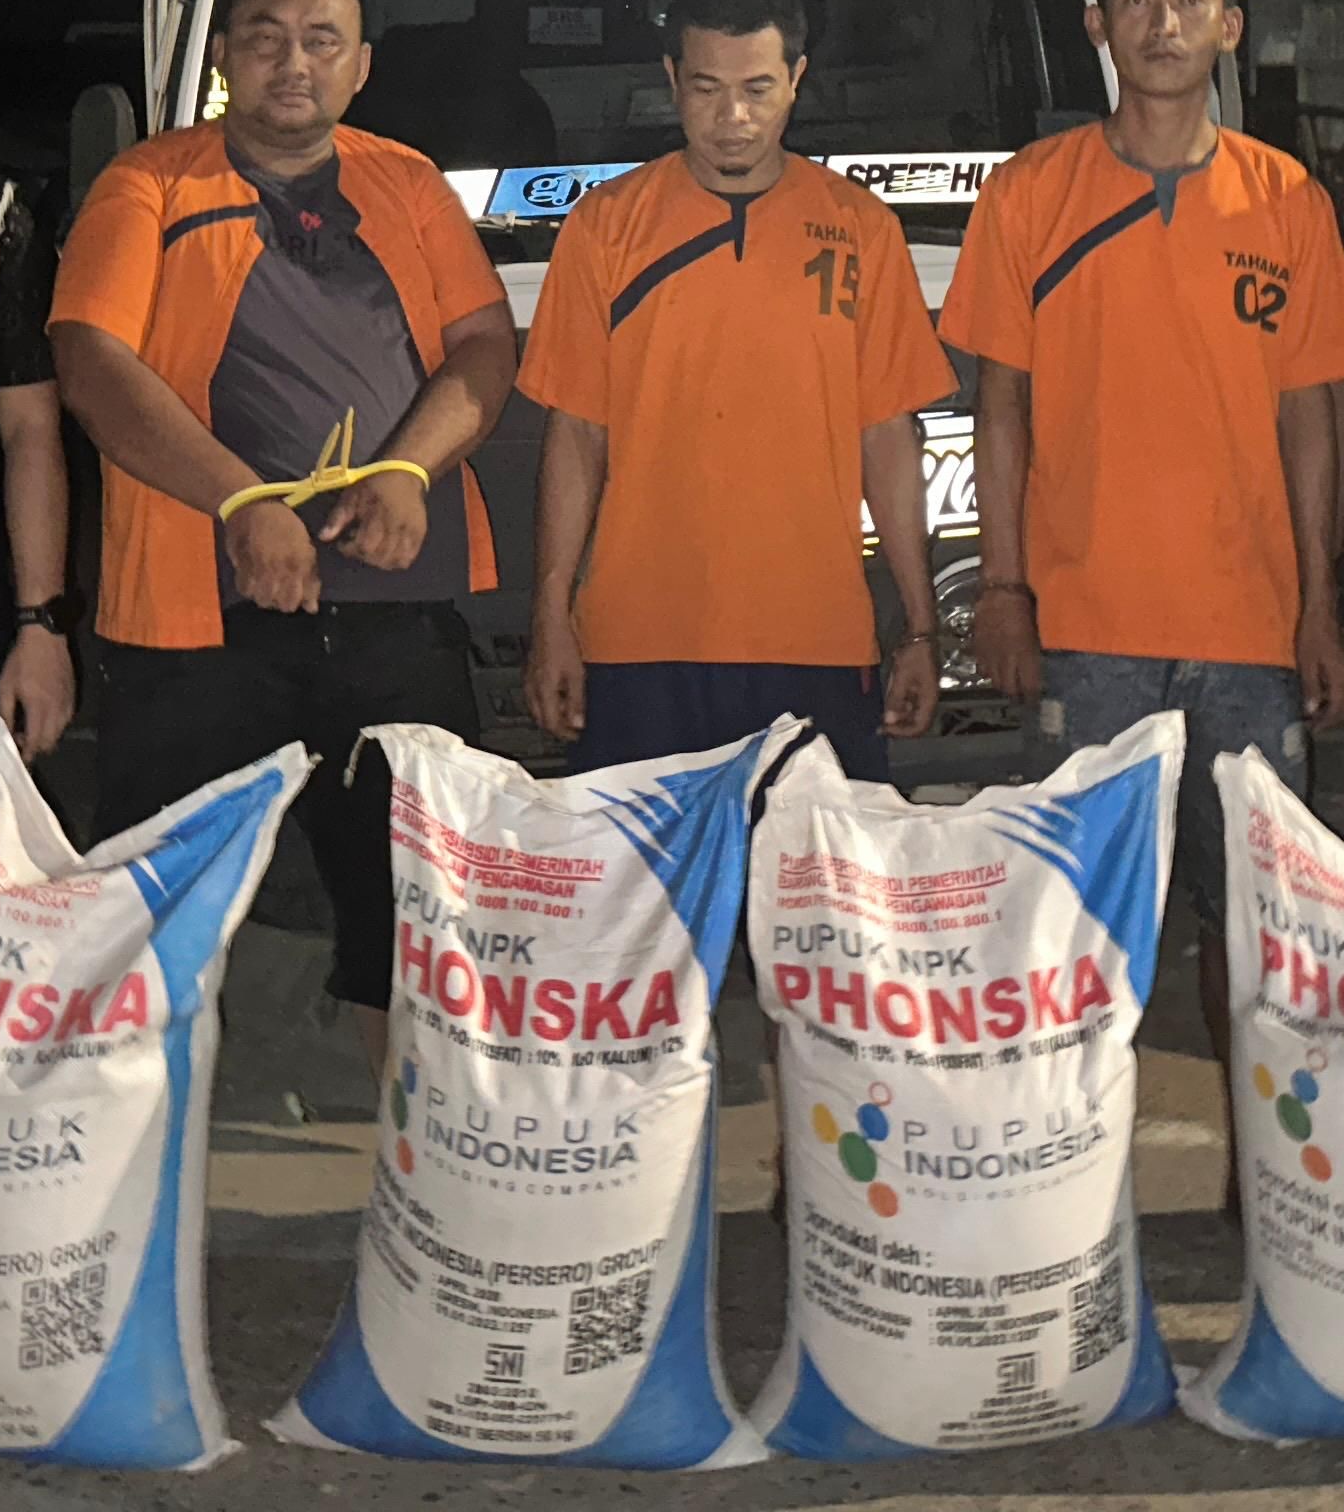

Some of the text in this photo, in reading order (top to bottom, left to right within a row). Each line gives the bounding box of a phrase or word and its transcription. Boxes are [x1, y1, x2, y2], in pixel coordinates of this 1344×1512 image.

[802, 221, 853, 244] TAHA
[1234, 273, 1287, 335] 02
[504, 846, 605, 876] PEMERINTAH
[908, 860, 1007, 893] PEMERINTAH
[466, 924, 537, 966] NPK
[773, 923, 975, 978] PUPUK NPK
[773, 952, 1114, 1044] PHONSKA
[426, 1084, 641, 1145] PUPUK
[903, 1094, 1104, 1152] PUPUK
[424, 1116, 641, 1176] INDONESIA
[903, 1121, 1107, 1181] INDONESIA
[50, 1230, 117, 1266] GROUP
[882, 1234, 920, 1267] oleh
[488, 1260, 593, 1288] (PERSERO)
[880, 1268, 986, 1300] INDONESIA
[484, 1348, 525, 1379] SNI
